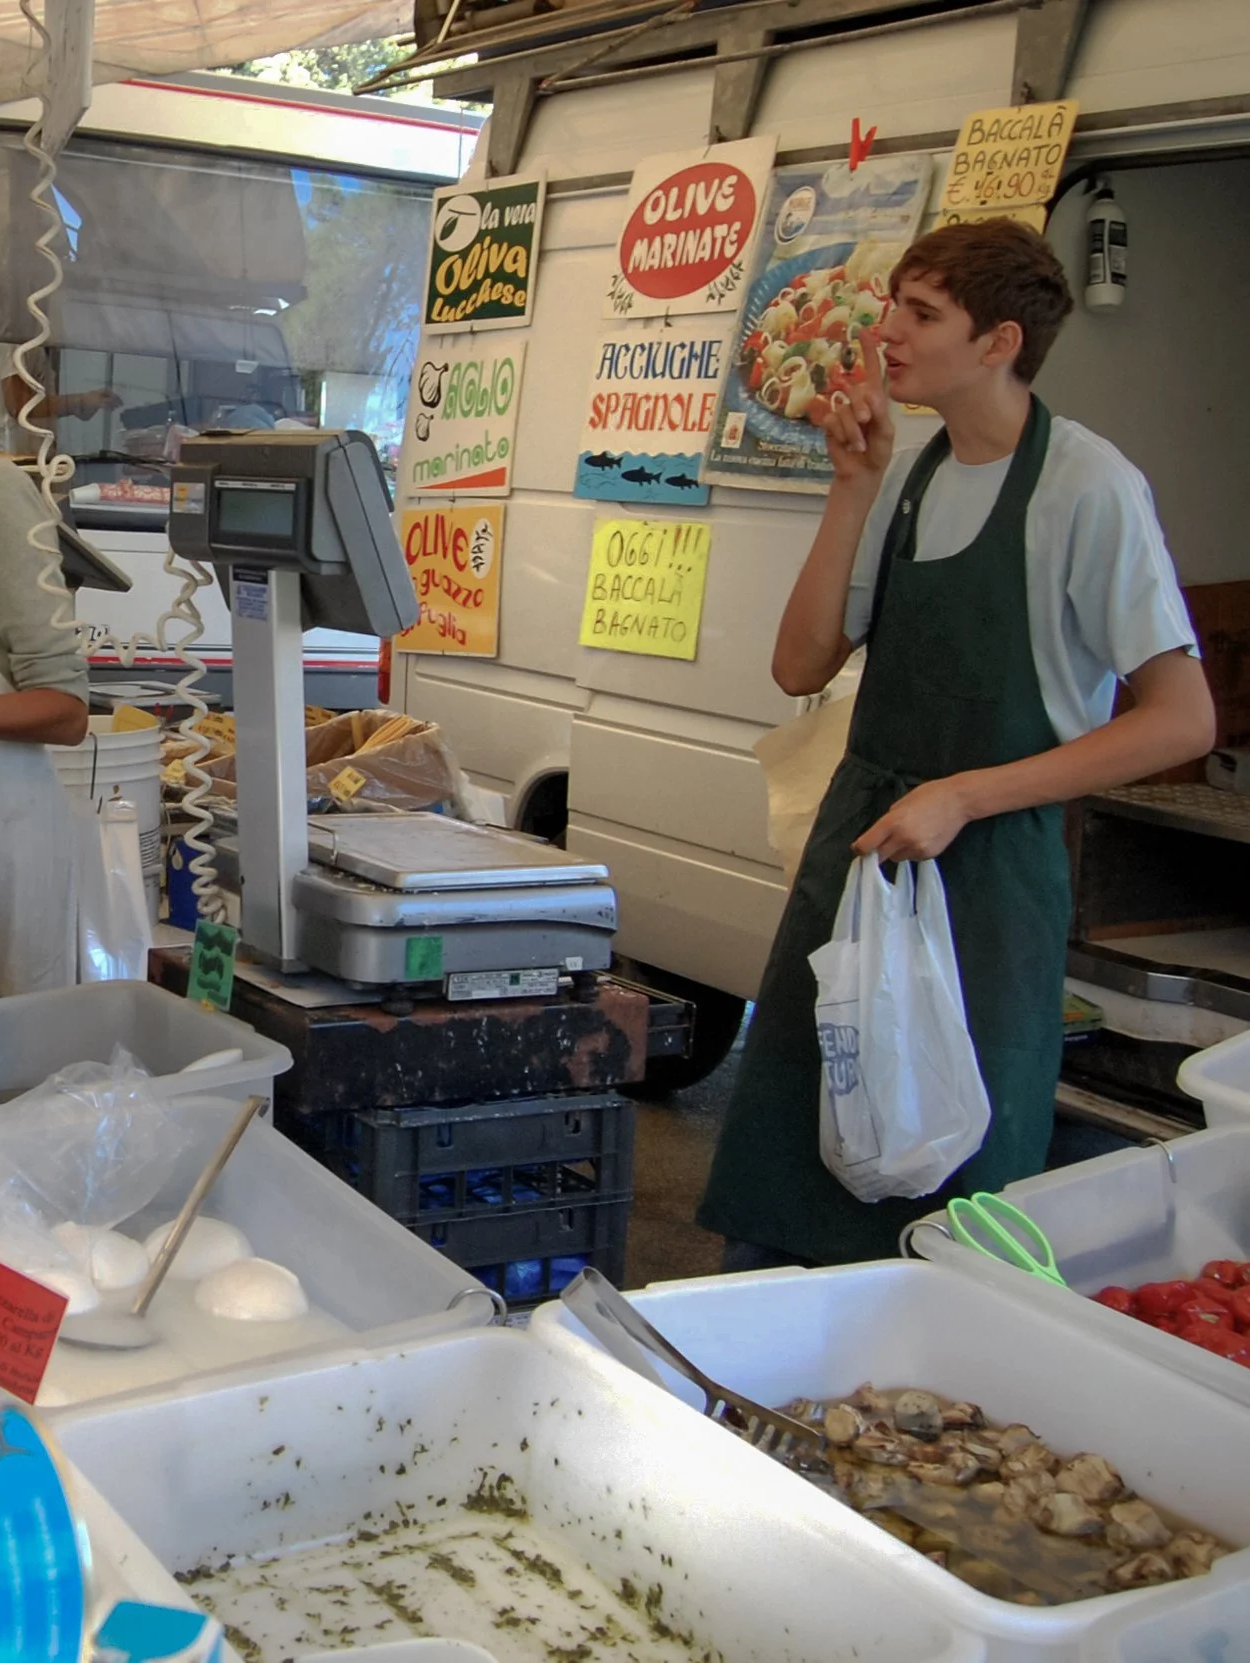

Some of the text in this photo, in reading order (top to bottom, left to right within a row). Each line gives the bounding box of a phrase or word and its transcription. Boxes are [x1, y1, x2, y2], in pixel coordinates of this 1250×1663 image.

[953, 143, 1062, 177] BAGNATO
[479, 200, 536, 231] la vera
[643, 173, 738, 226] OLIVE
[435, 235, 528, 297] Oliva
[626, 220, 741, 274] MARINATE
[431, 278, 526, 323] Lucchese
[596, 340, 723, 381] ACCIUGHE
[441, 356, 516, 420] AGLIO
[588, 392, 717, 433] SPAGNOLE
[413, 429, 510, 483] marinato
[405, 513, 469, 573] OLIVE
[420, 568, 485, 610] guazzo
[593, 608, 687, 643] BAGNATO
